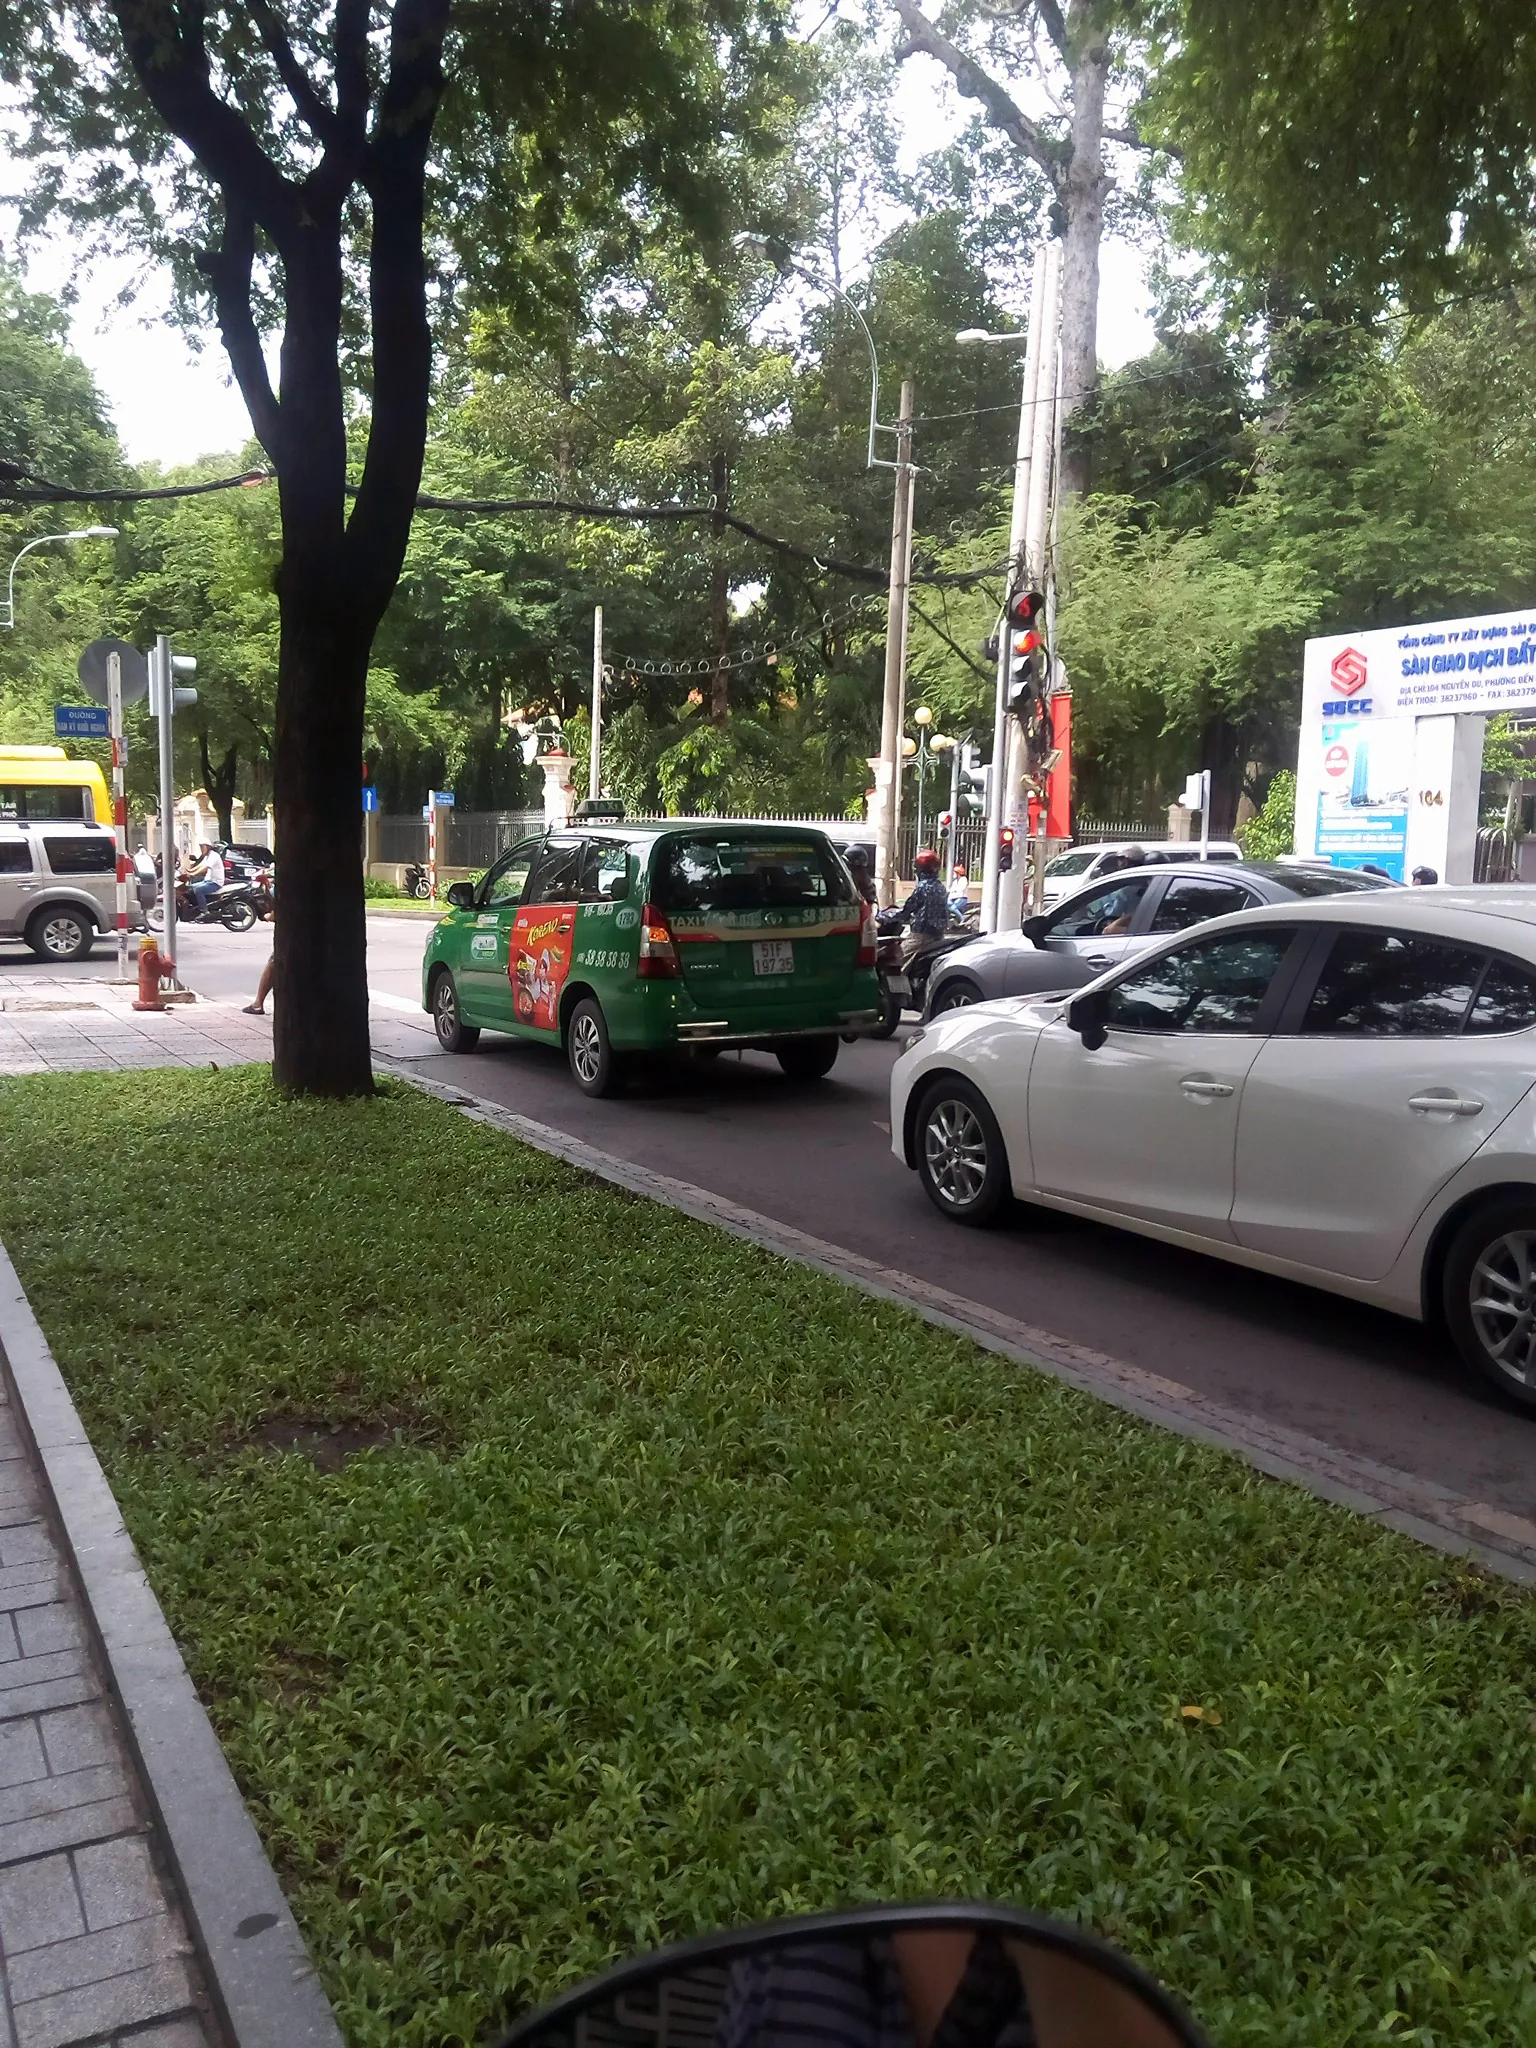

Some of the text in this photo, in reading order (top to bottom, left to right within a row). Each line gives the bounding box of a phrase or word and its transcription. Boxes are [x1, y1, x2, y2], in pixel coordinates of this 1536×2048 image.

[1447, 632, 1459, 643] TY
[1461, 628, 1479, 641] XÂY
[1401, 637, 1536, 676] SÀN GIAO DỊCH BẤT
[1419, 790, 1443, 807] 104
[669, 915, 700, 928] TAXI
[526, 917, 559, 947] KORENO
[761, 943, 783, 958] 51F
